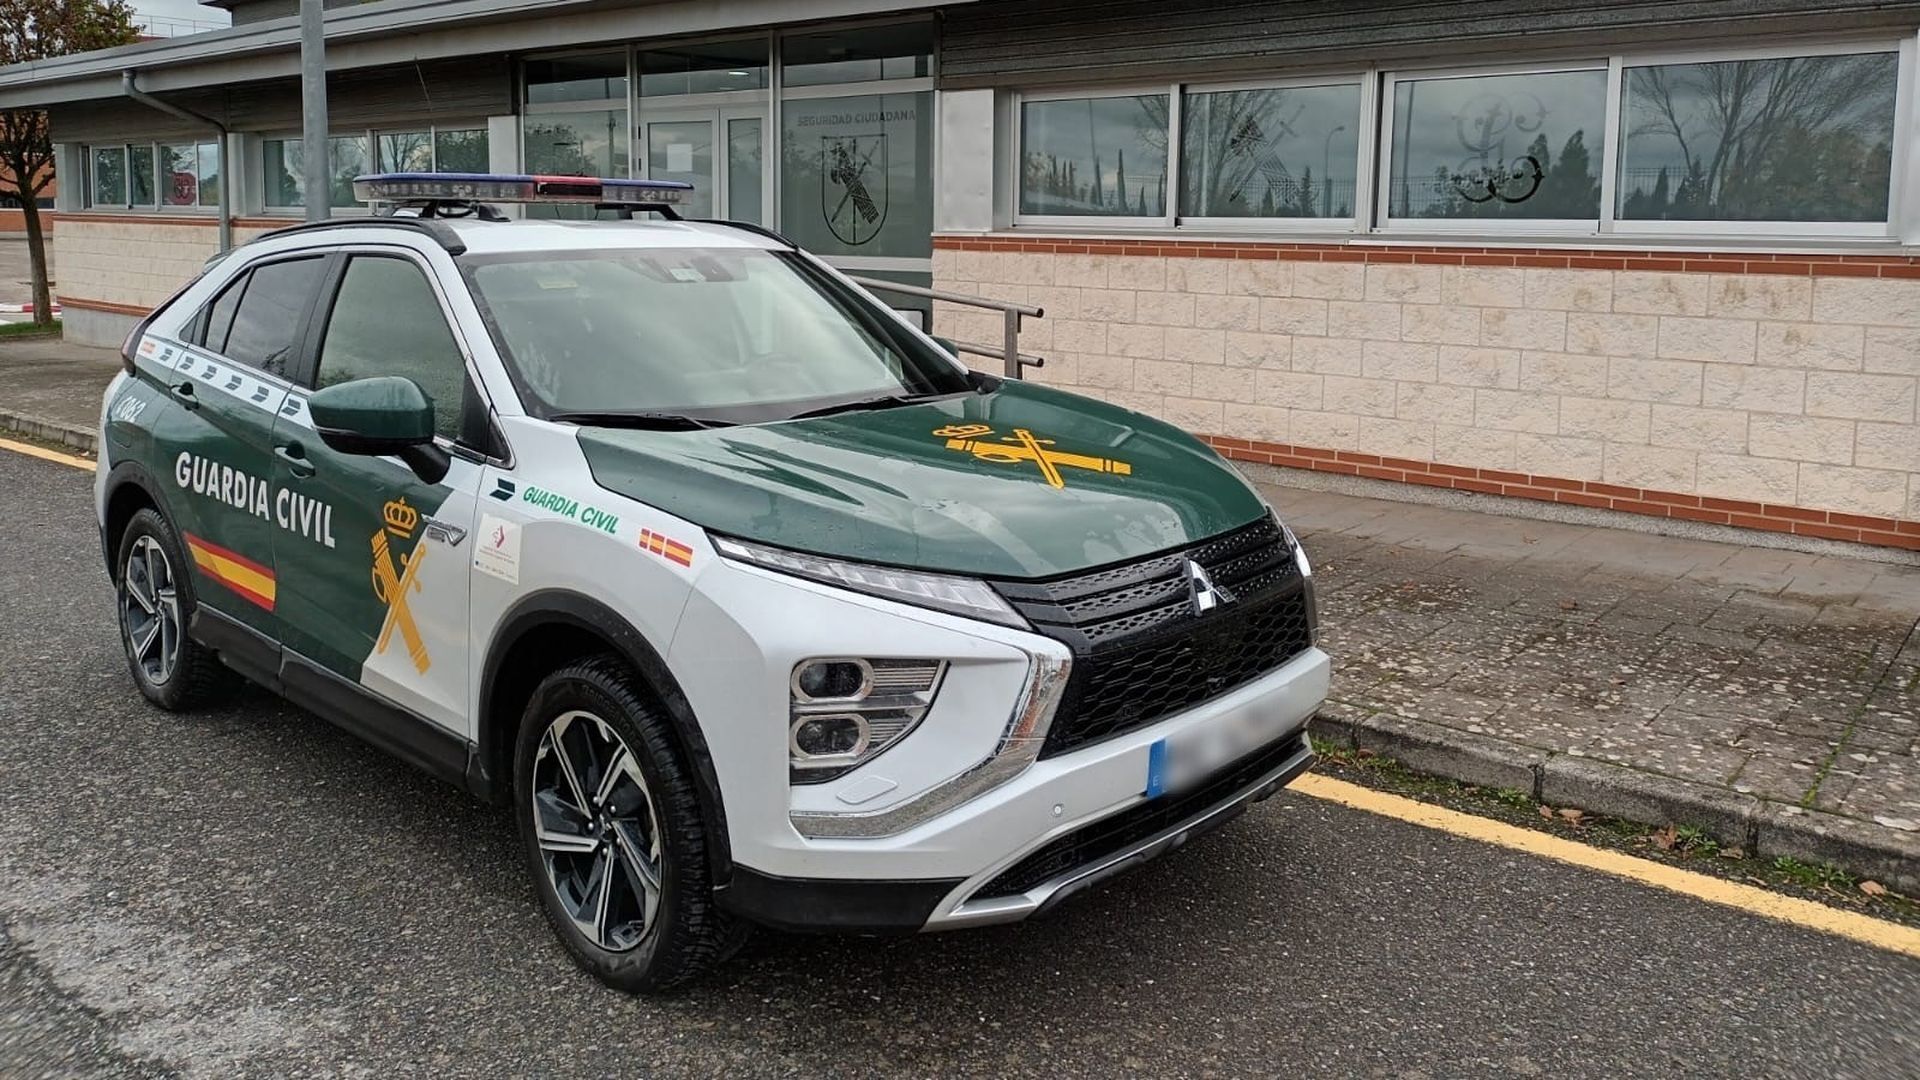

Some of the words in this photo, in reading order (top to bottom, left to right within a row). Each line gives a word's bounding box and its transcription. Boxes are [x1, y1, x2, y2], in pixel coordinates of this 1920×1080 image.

[798, 113, 852, 127] SEGURIDAD
[855, 110, 916, 124] CIUDADANA
[175, 451, 270, 521] GUARDIA
[276, 488, 336, 548] CIVIL
[523, 486, 578, 518] GUARDIA
[581, 507, 619, 534] CIVIL
[1152, 775, 1159, 787] E
